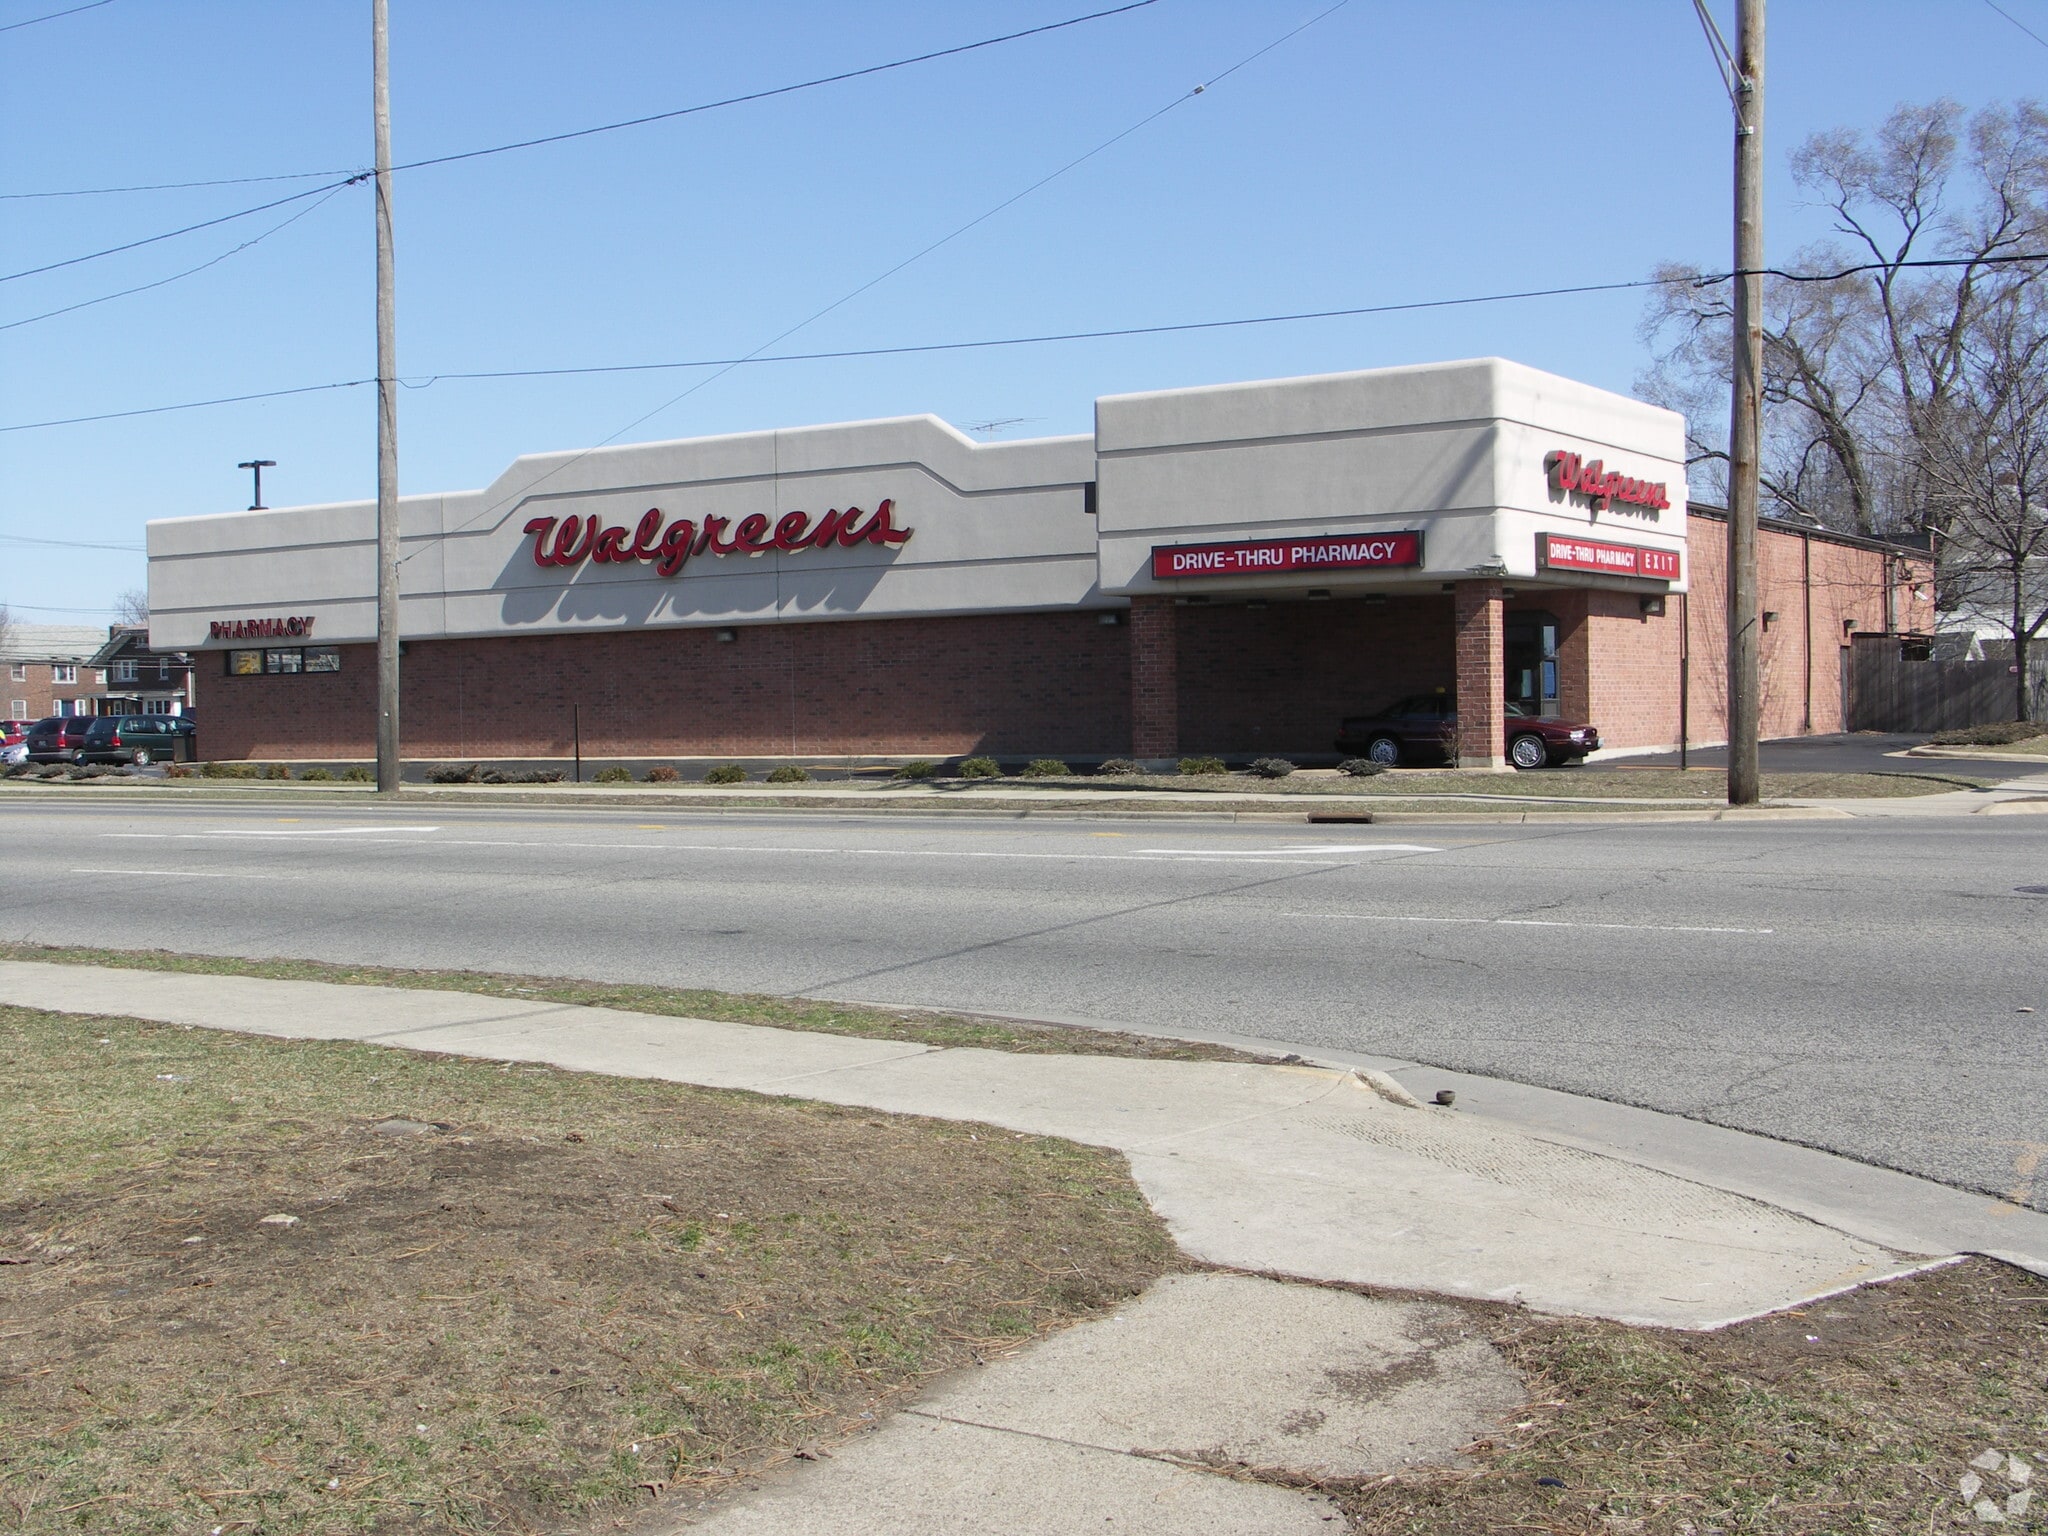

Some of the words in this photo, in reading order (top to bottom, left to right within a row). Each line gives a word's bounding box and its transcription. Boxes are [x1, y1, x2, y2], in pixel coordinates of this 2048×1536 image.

[1544, 450, 1670, 510] Walgreens
[524, 499, 912, 577] Walgreens
[1173, 548, 1283, 571] DRIVE-THRU
[1291, 542, 1395, 563] PHARMACY
[1550, 543, 1594, 563] DRIVE-THRU
[1597, 548, 1635, 566] PHARMACY
[210, 616, 313, 639] PHARMACY
